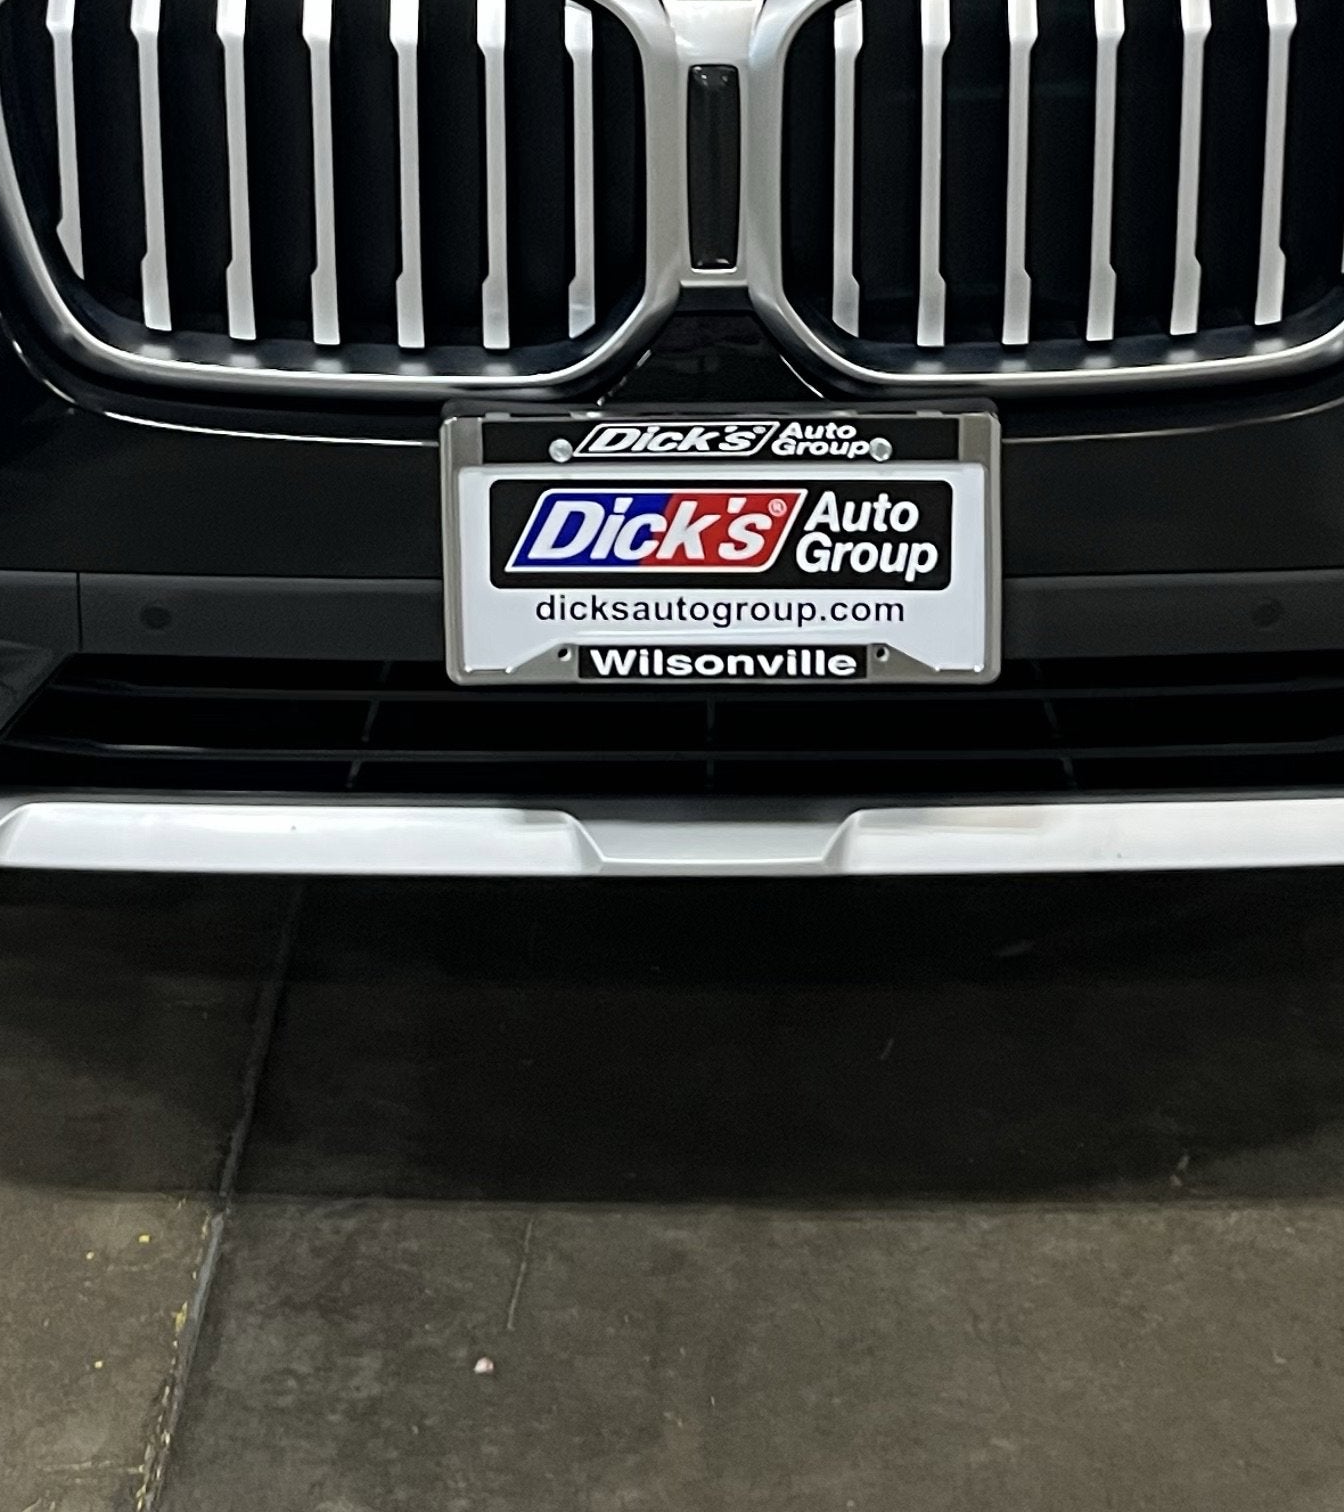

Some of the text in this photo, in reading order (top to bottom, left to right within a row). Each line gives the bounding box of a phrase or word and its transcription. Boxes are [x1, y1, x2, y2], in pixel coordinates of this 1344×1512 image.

[779, 422, 857, 439] Auto
[771, 437, 871, 458] Group
[804, 491, 919, 533] Auto
[796, 532, 938, 582] Group
[536, 594, 905, 627] dicksautogroup.com
[589, 649, 857, 677] Wilsonville
